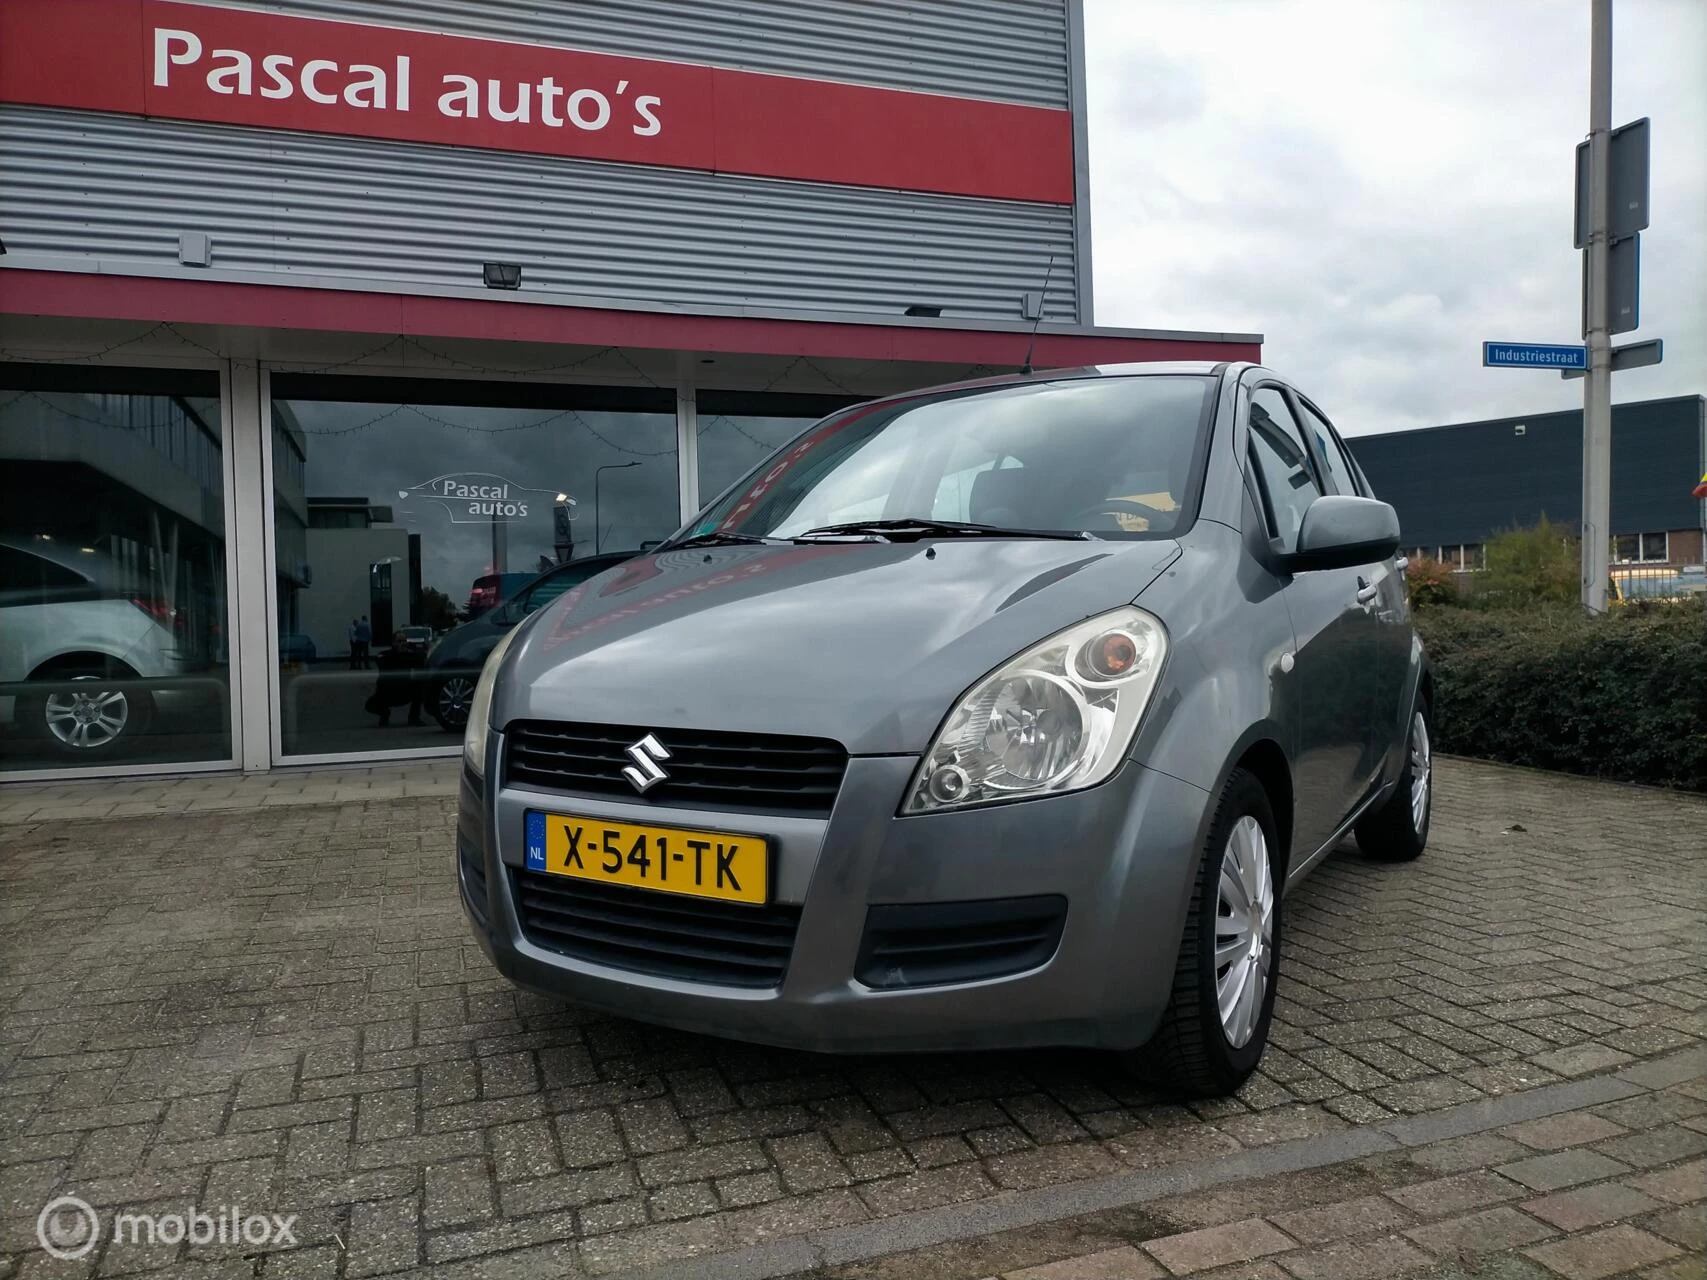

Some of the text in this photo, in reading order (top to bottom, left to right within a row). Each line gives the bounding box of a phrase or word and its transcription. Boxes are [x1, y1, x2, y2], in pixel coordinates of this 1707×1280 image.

[153, 27, 662, 137] Pascal auto's
[1495, 348, 1578, 364] Industriestraat
[443, 480, 508, 499] Pascal
[468, 501, 528, 517] auto's
[530, 846, 544, 861] NL
[563, 825, 741, 891] X-541-TK
